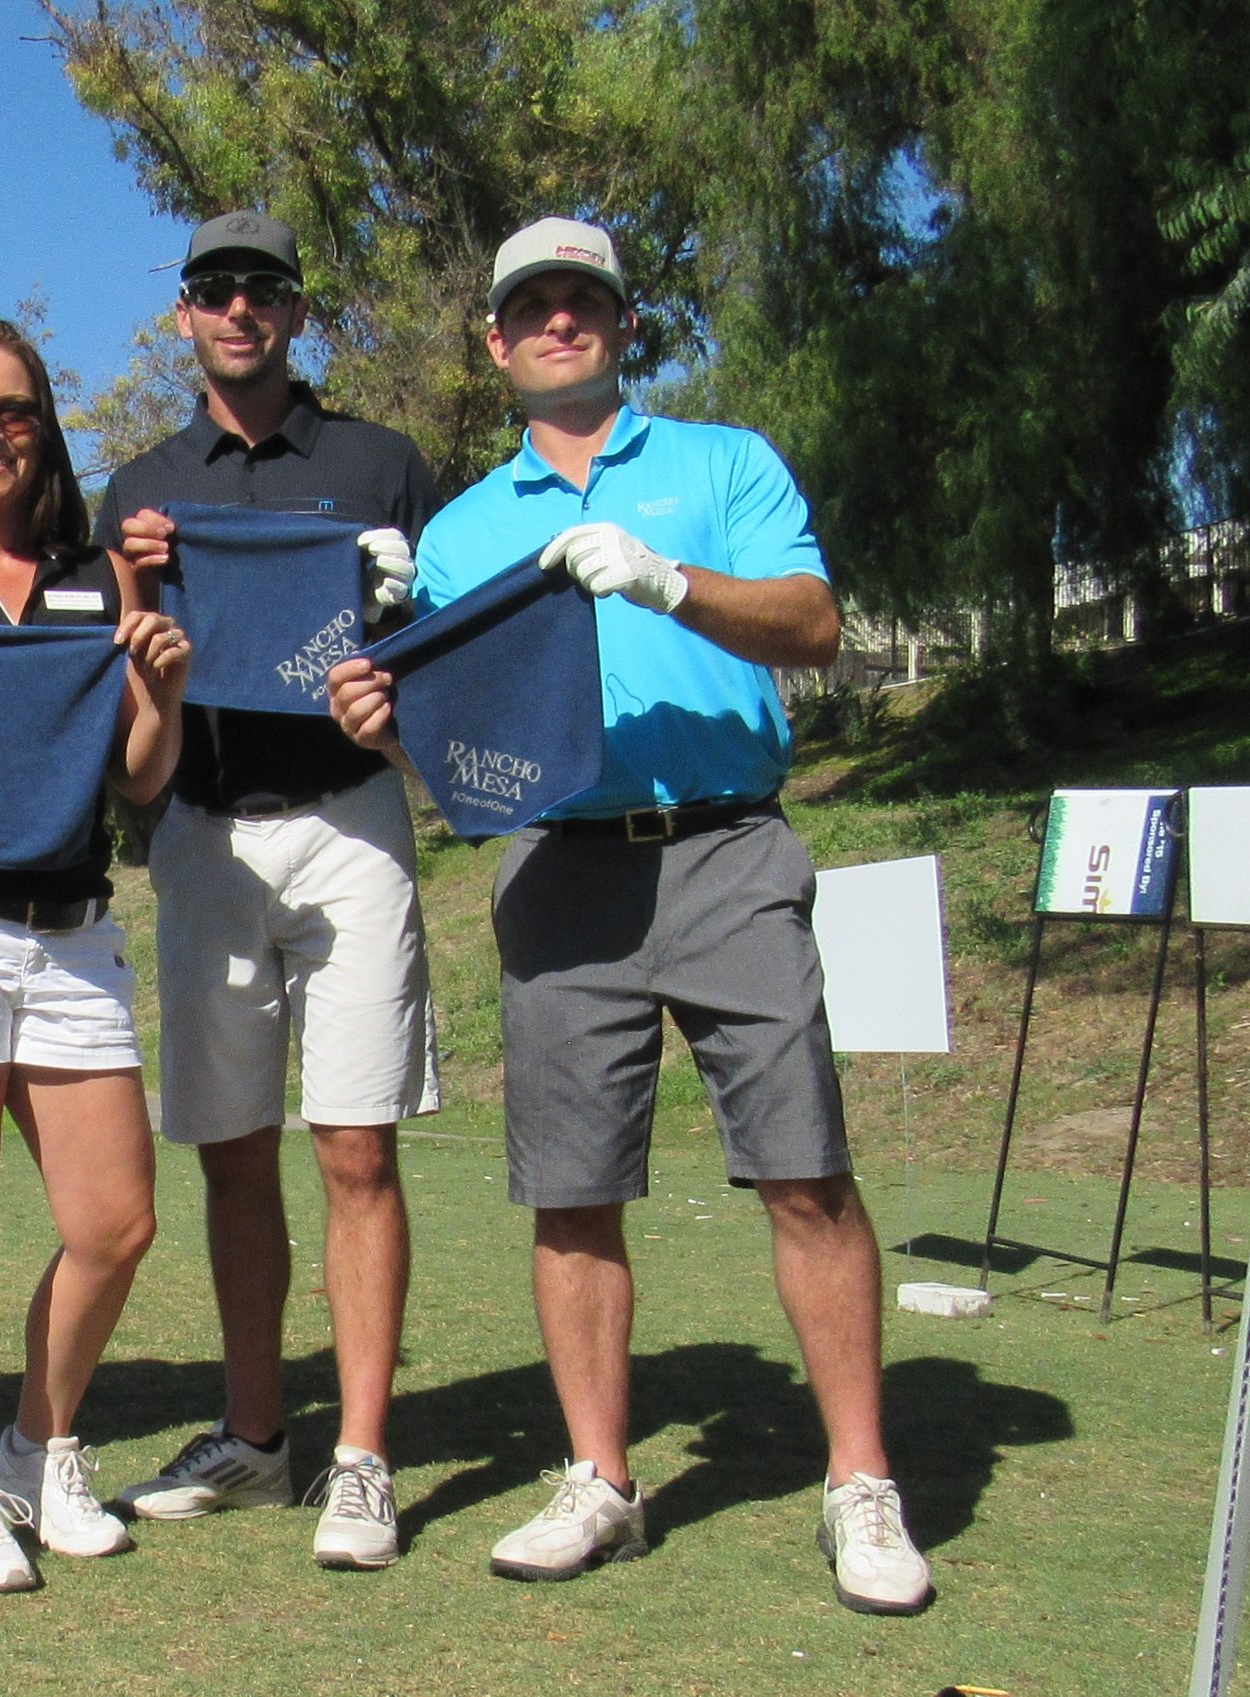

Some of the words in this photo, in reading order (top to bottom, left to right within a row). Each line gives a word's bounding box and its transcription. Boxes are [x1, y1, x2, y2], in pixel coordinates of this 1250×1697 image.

[274, 608, 356, 686] RANCHO
[297, 636, 360, 694] MESA
[444, 739, 542, 783] RANCHO
[448, 762, 524, 802] MESA
[1143, 809, 1161, 873] Sponsored
